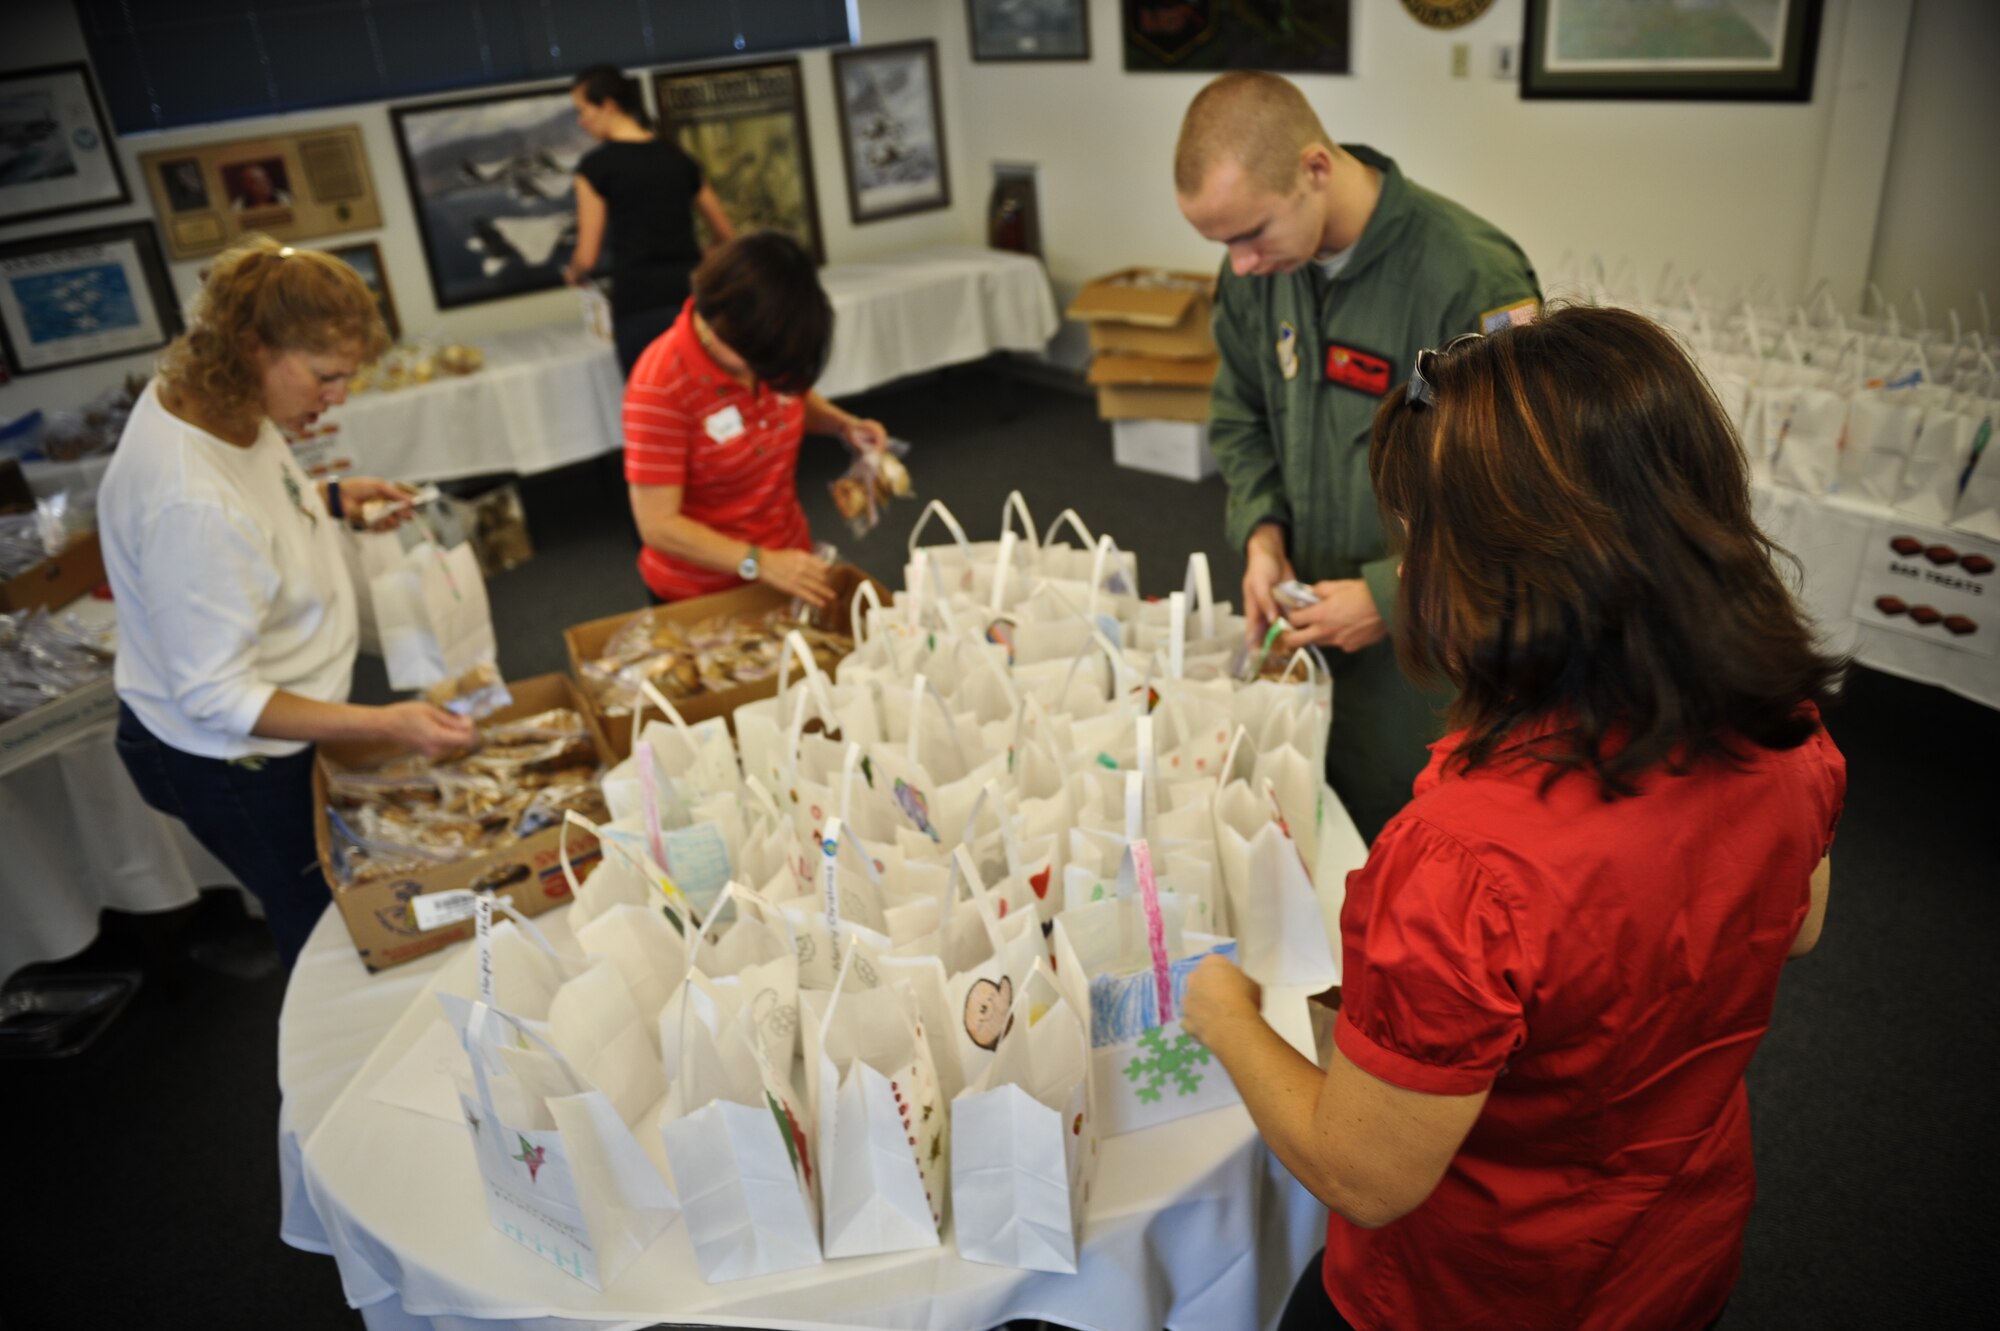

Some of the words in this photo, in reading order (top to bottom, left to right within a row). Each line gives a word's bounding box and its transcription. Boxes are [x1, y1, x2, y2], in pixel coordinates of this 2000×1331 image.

[1890, 561, 1920, 579] BAR
[1925, 569, 1984, 596] TREATS
[825, 865, 836, 926] Christmas
